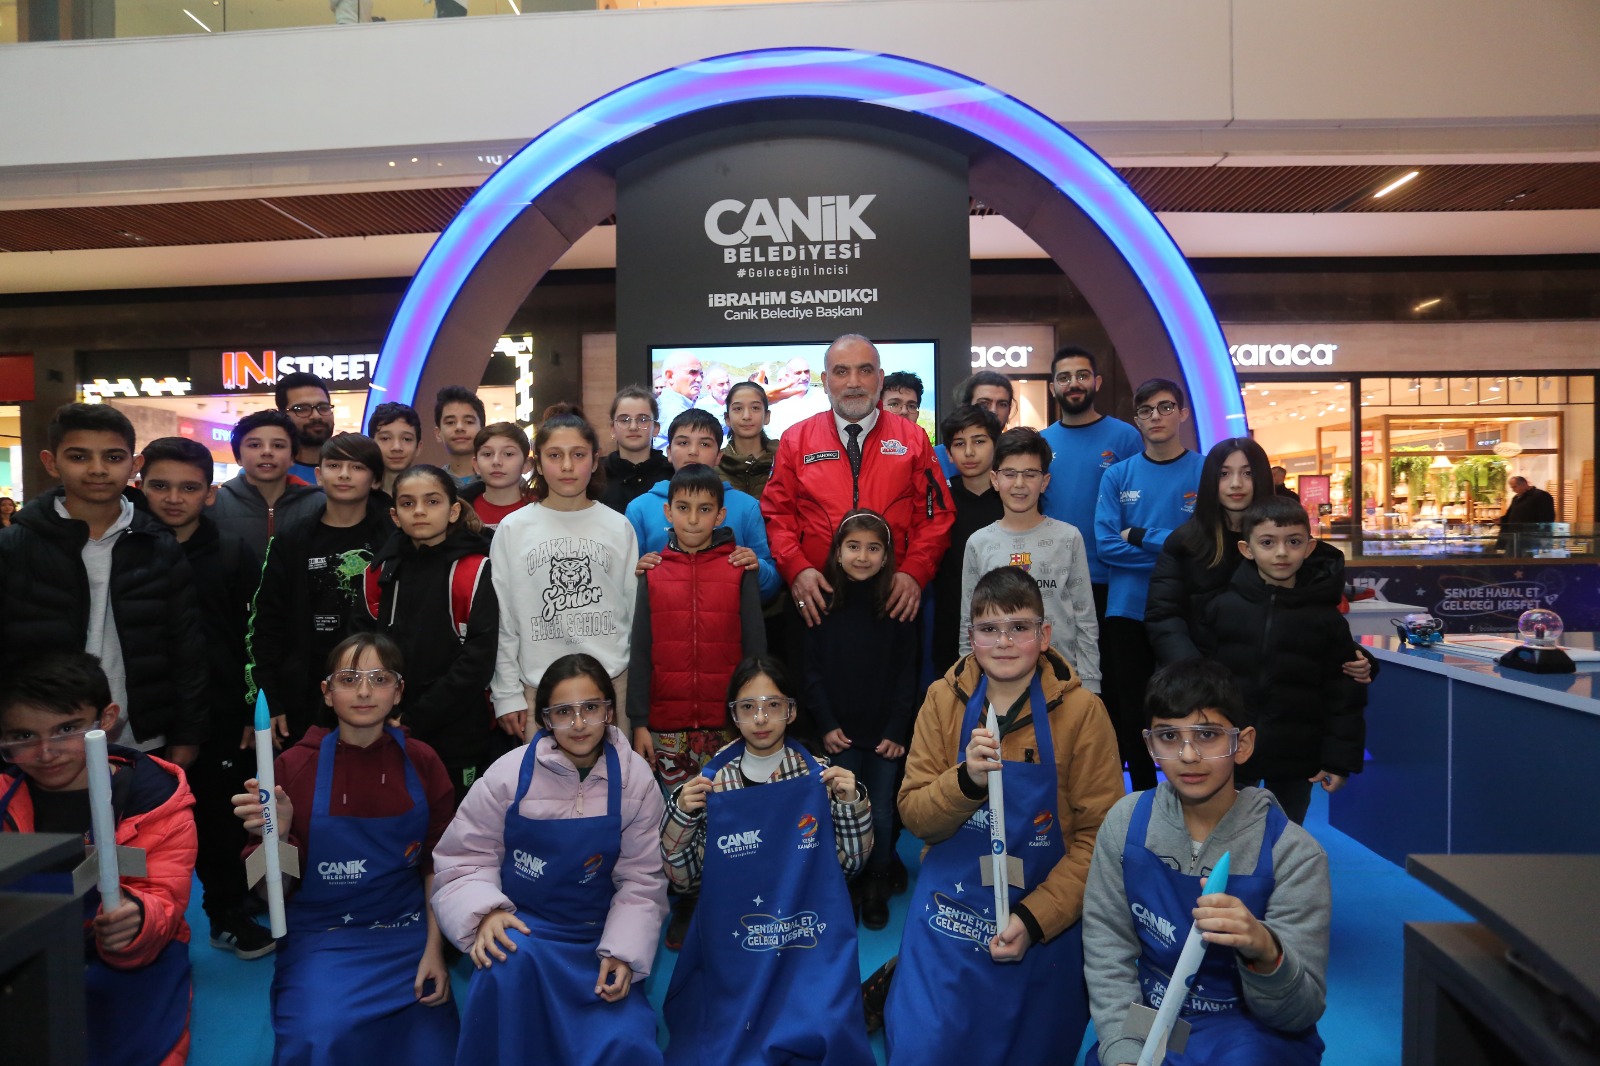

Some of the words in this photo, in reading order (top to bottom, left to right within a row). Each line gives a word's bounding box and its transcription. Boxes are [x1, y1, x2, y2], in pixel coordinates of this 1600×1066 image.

[737, 265, 809, 278] #Geleceğin
[813, 263, 849, 275] İncisi
[790, 288, 878, 303] SANDIKÇI
[724, 307, 758, 320] Canik
[760, 306, 813, 320] Belediye
[816, 305, 863, 318] Başkanı
[1229, 344, 1333, 366] karaca
[526, 537, 610, 576] OAKLAND
[1486, 587, 1523, 598] HAYAL
[1526, 587, 1540, 598] ET
[542, 584, 603, 622] Senior
[531, 613, 564, 641] HIGH
[567, 611, 617, 637] SCHOOL
[263, 806, 274, 835] canik
[801, 916, 813, 926] ET
